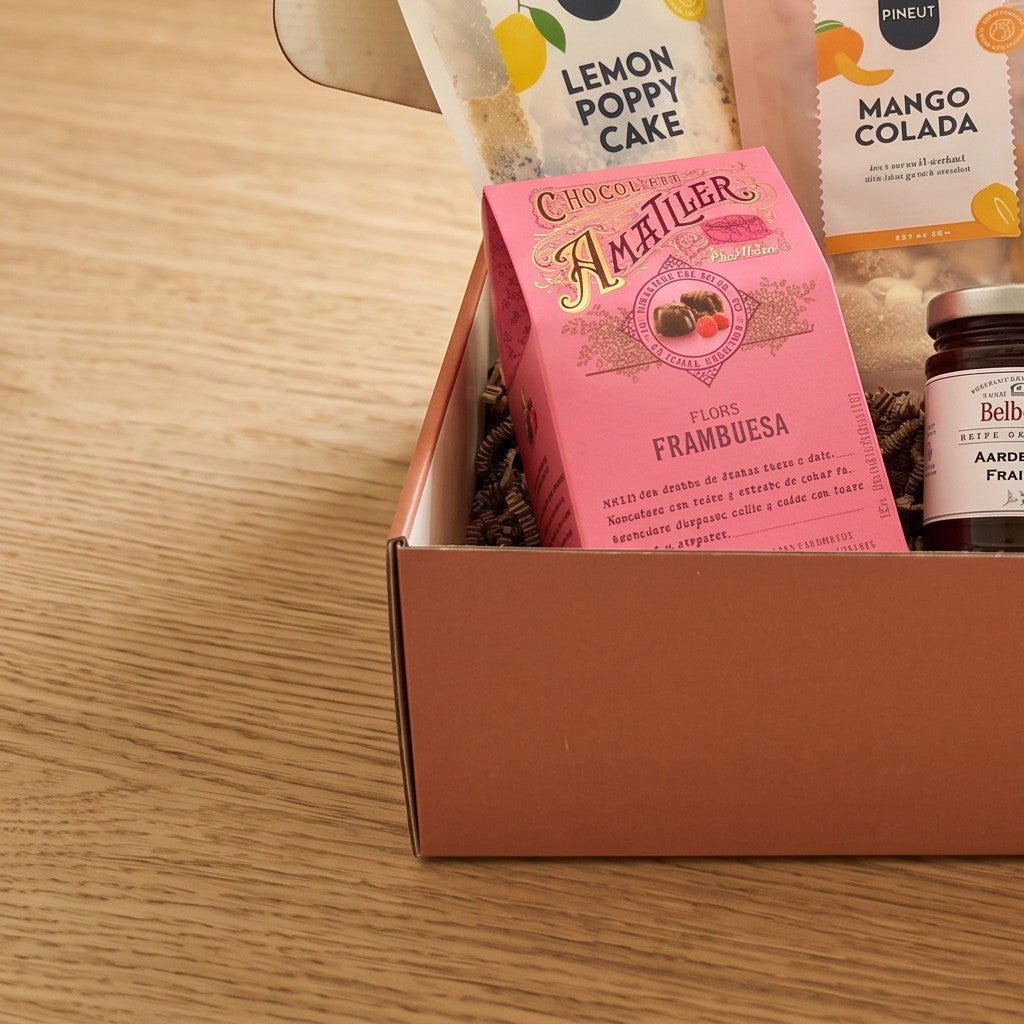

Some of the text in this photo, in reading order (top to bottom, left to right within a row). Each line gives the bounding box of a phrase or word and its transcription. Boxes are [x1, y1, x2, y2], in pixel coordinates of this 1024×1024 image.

[882, 5, 936, 21] PINEUT
[562, 46, 674, 95] LEMON
[575, 76, 679, 126] POPPY
[858, 86, 970, 120] MANGO
[599, 110, 684, 153] CAKE
[855, 112, 978, 146] COLADA
[689, 402, 740, 423] FLORS
[652, 412, 790, 461] FRAMBUESA
